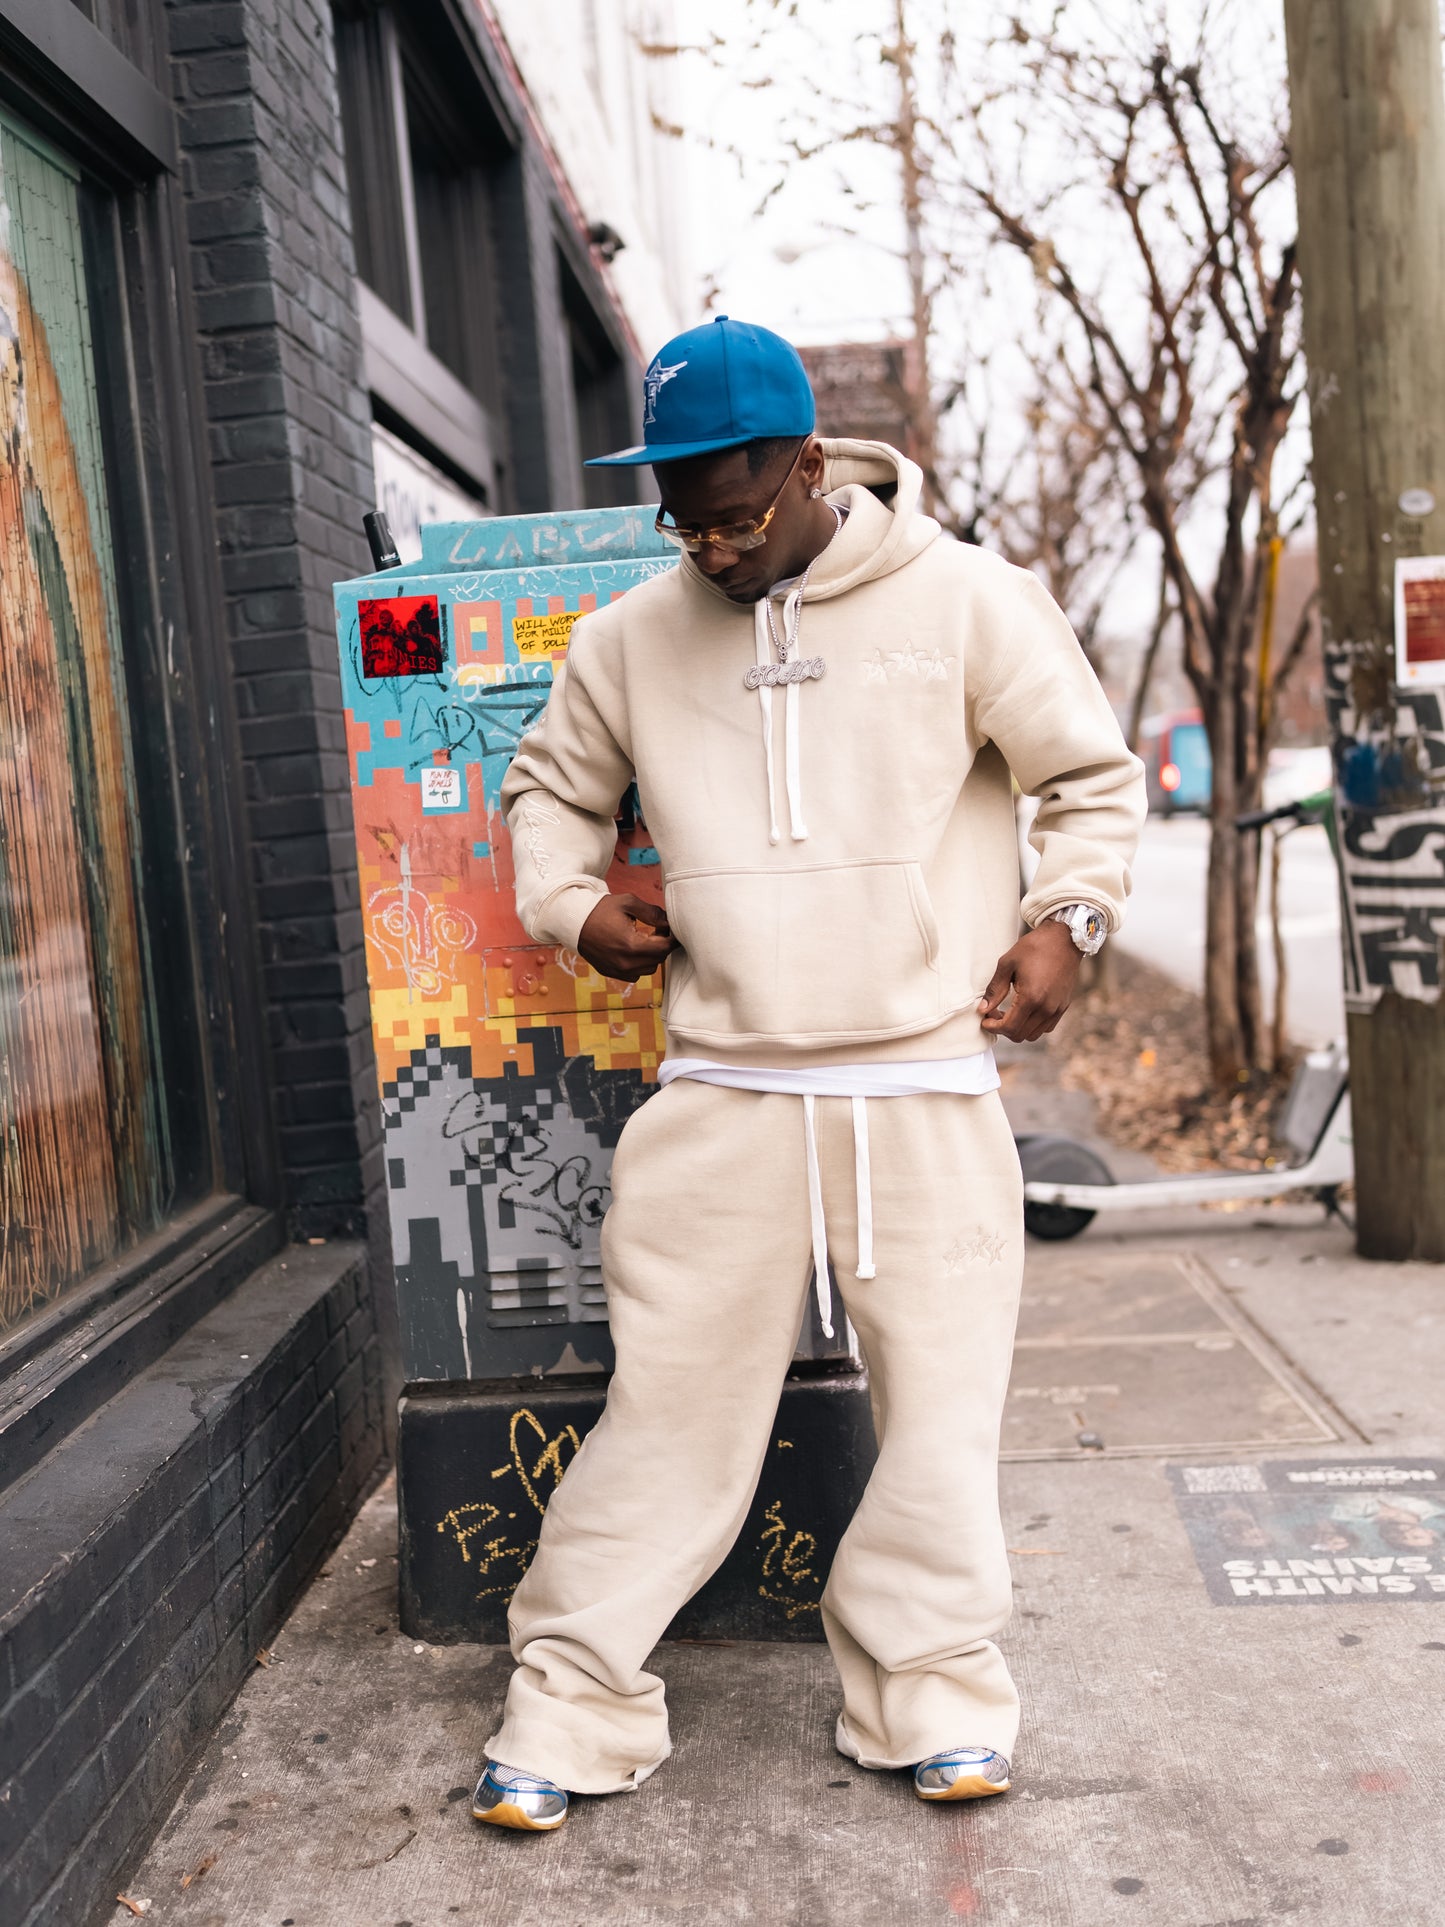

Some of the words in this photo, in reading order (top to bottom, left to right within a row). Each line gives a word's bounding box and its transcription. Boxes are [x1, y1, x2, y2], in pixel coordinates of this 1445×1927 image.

[515, 619, 546, 631] WILL
[516, 631, 539, 640] FOR
[521, 640, 535, 650] OF
[1222, 1556, 1432, 1578] SAINTS
[1229, 1575, 1416, 1597] SMITH
